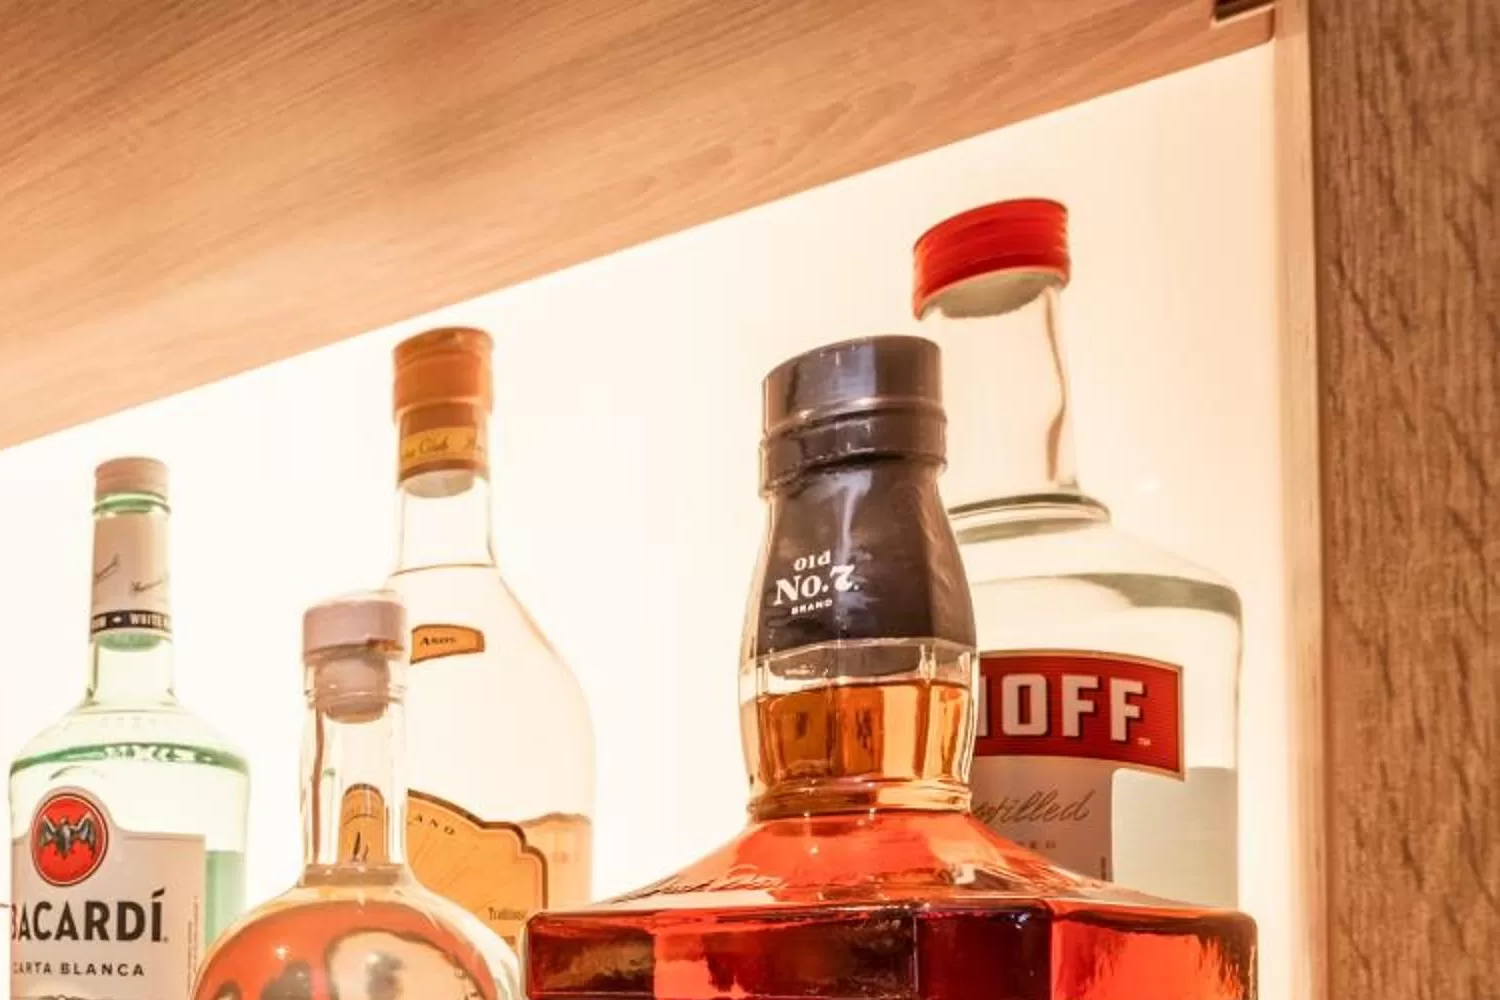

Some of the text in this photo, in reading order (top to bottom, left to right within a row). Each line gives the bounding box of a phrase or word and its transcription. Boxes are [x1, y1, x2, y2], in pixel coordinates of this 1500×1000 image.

[794, 549, 831, 571] Old
[791, 598, 833, 615] BRAND
[60, 963, 145, 977] BLANCA
